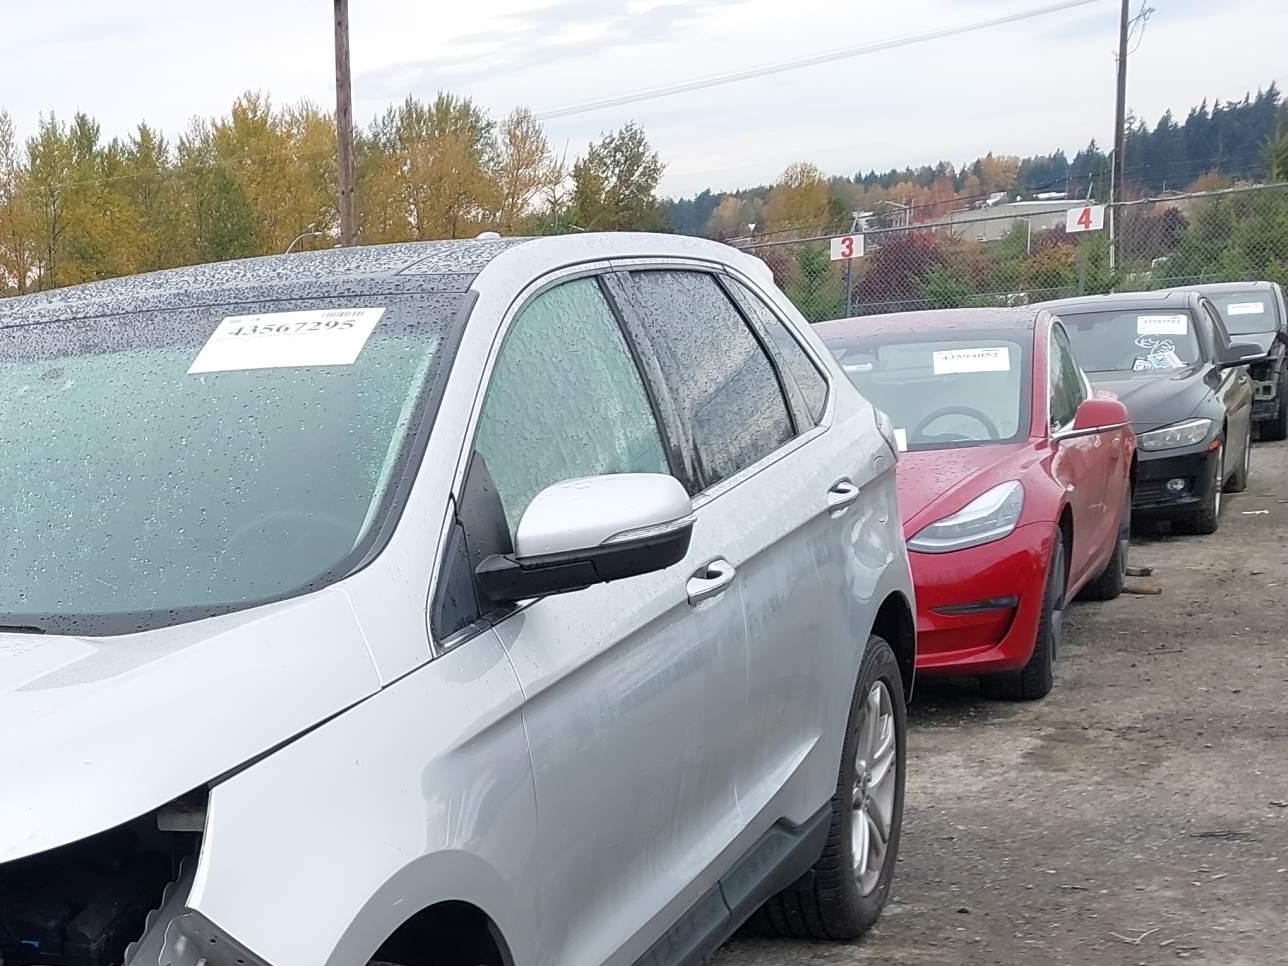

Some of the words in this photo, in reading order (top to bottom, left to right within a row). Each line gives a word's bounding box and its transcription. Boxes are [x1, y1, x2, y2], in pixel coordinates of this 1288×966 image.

[1077, 207, 1092, 229] 4
[840, 236, 854, 258] 3
[228, 319, 356, 336] 43567295
